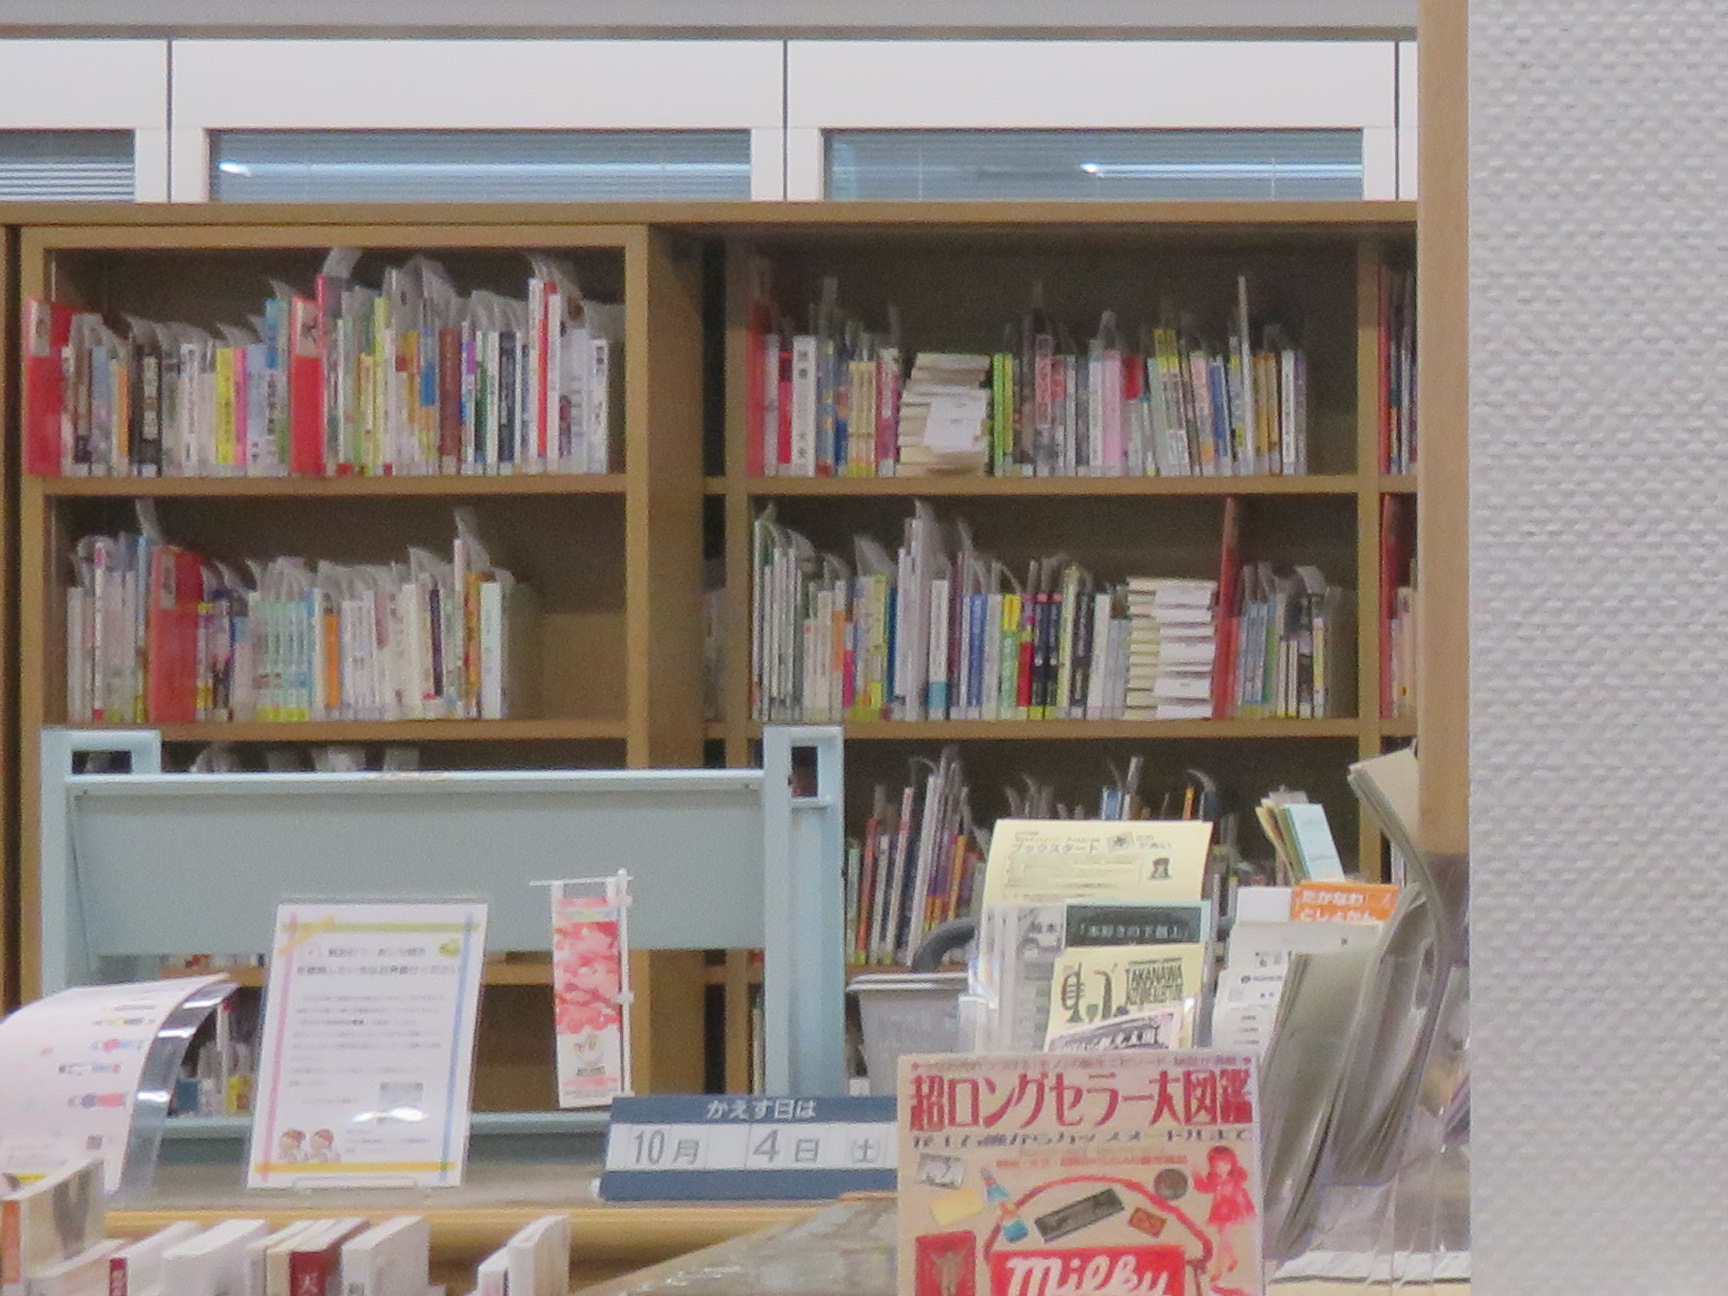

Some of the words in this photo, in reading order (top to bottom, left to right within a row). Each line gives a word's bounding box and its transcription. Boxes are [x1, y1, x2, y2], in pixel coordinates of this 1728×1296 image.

[1300, 890, 1364, 907] たかなわ
[706, 1099, 816, 1121] かえす日は
[909, 1068, 1253, 1133] 超ロングセラー大図鑑
